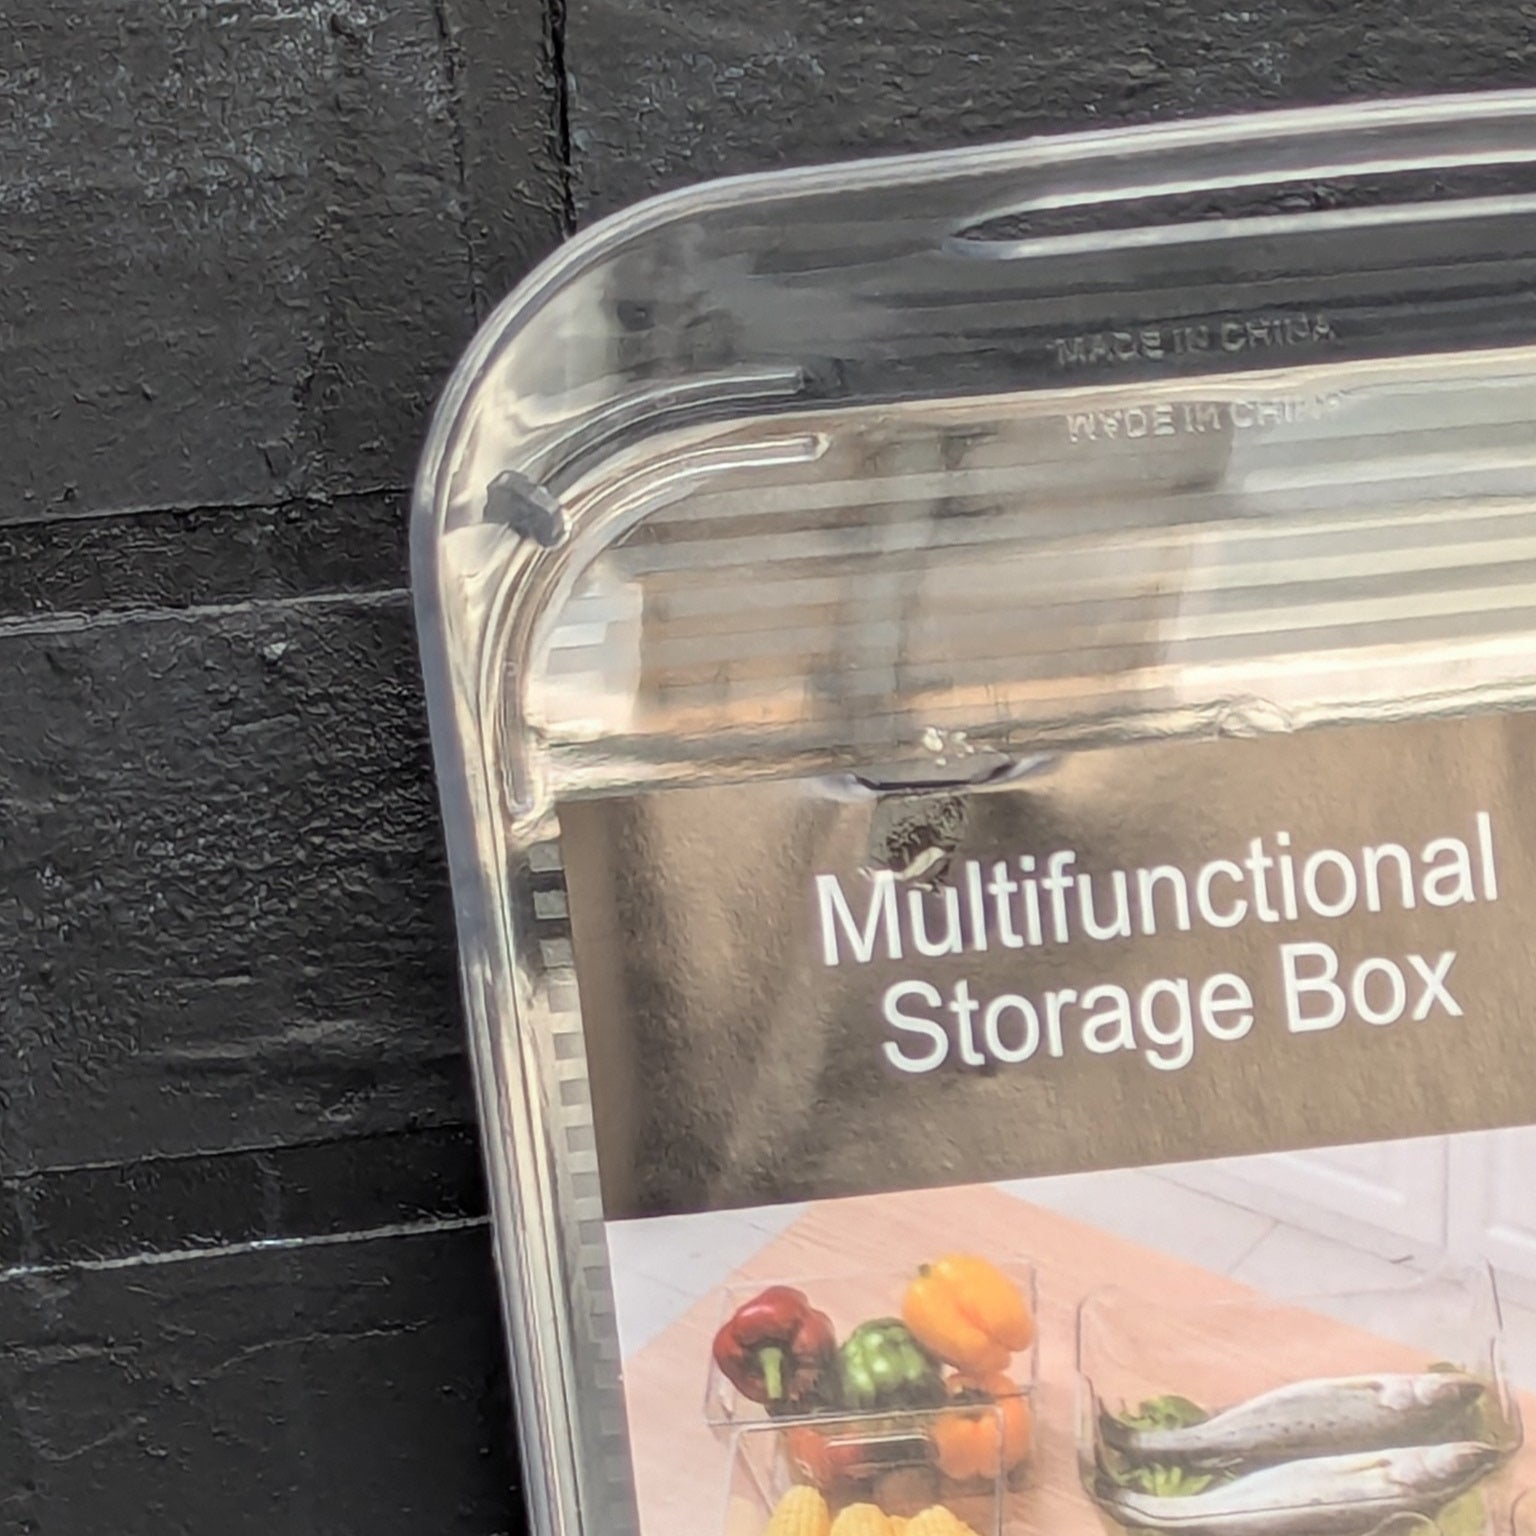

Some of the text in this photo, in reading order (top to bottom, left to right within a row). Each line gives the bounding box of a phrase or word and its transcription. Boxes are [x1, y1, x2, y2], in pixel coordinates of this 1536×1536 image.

[1056, 313, 1338, 365] MADE IN CHINA
[815, 811, 1498, 966] Multifunctional
[882, 942, 1464, 1073] Storage Box
